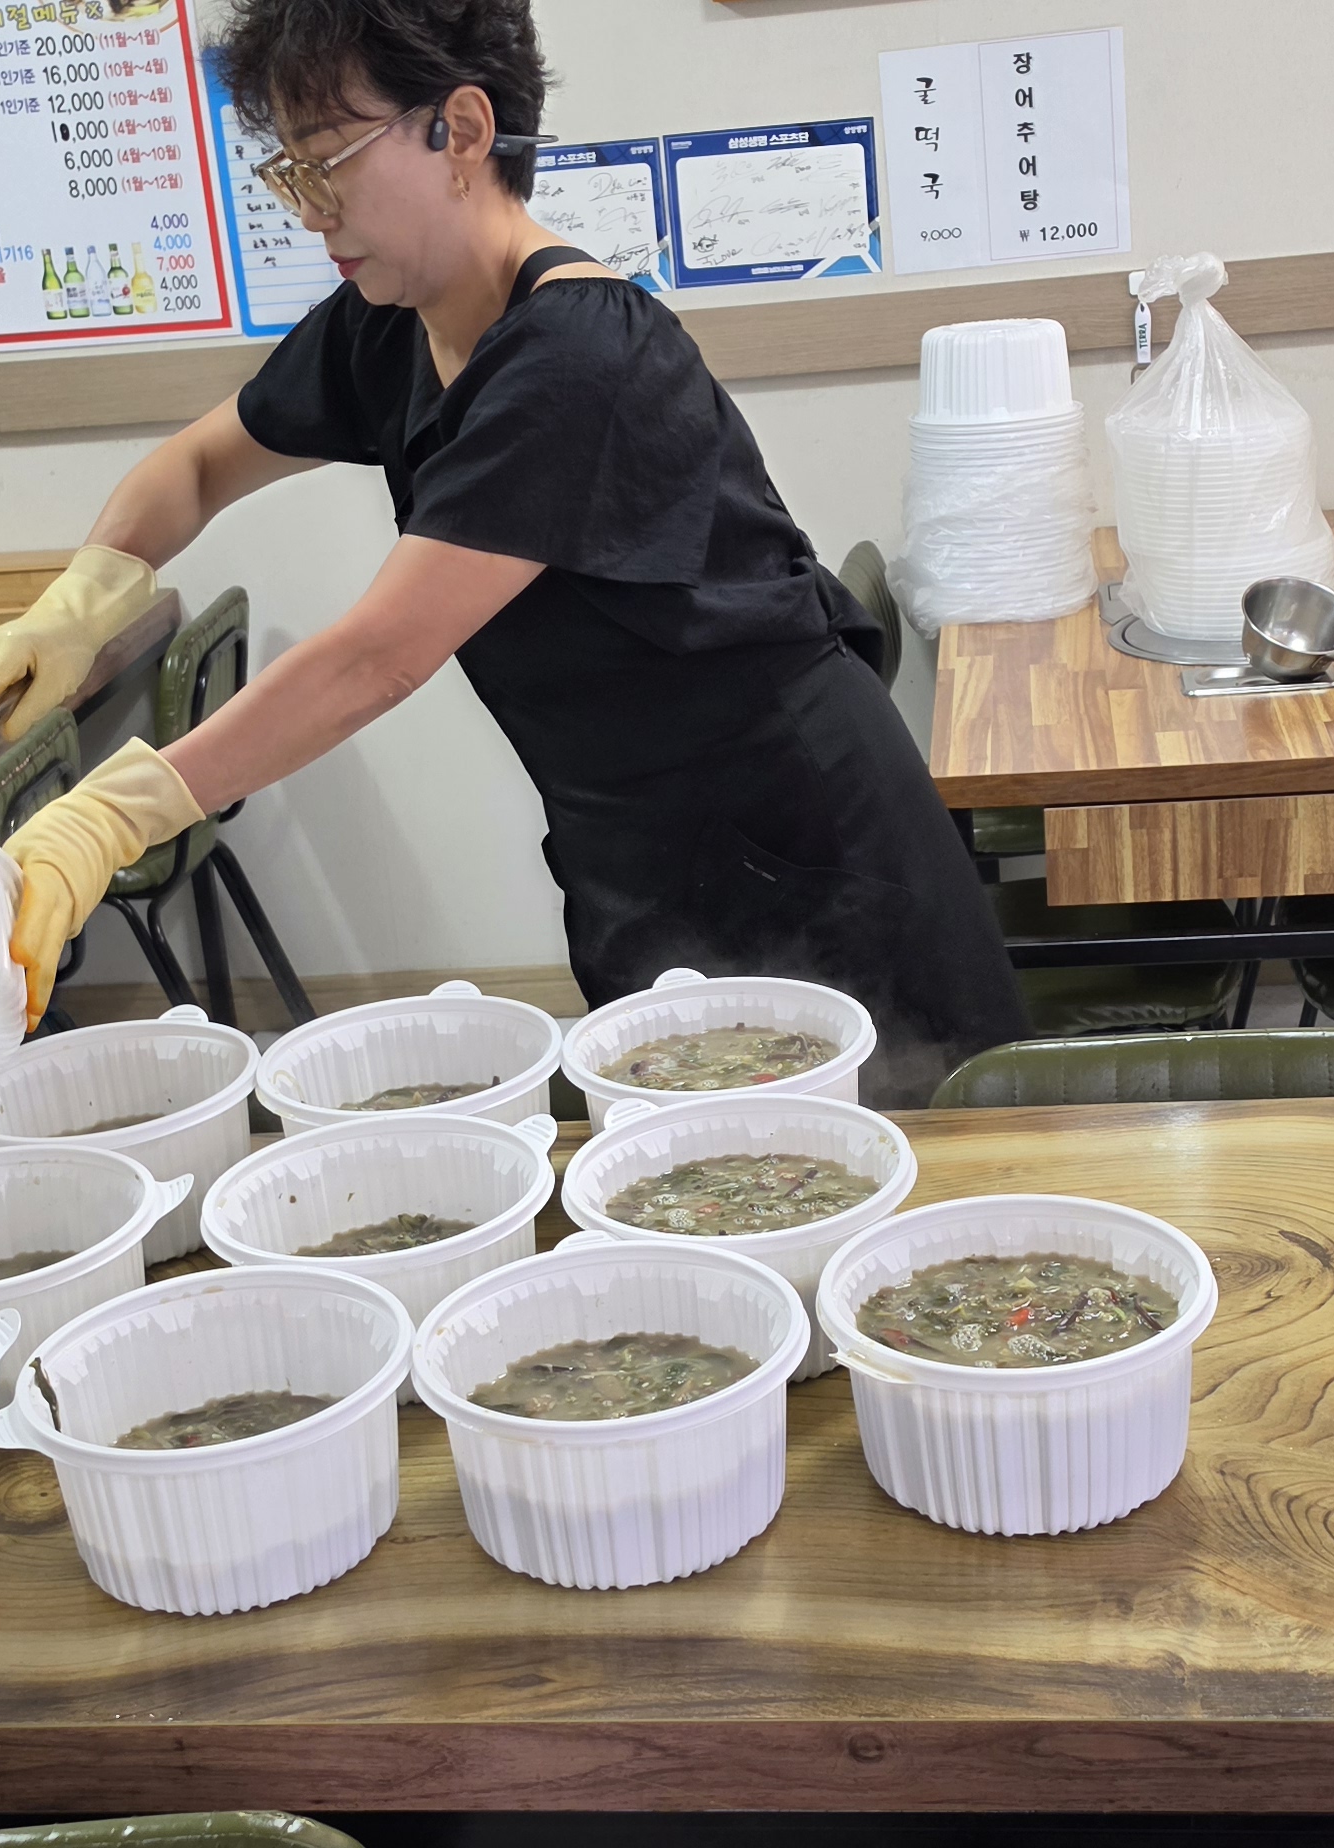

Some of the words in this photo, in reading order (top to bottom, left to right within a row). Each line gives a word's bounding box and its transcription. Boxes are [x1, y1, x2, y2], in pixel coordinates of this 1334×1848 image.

[35, 33, 95, 57] 20,000
[42, 62, 99, 86] 16,000
[0, 98, 41, 115] 1인기준
[47, 91, 104, 115] 12,000
[769, 131, 809, 145] 스포츠단
[64, 149, 113, 171] 6,000
[69, 177, 118, 200] 8,000
[151, 213, 189, 231] 4,000
[920, 227, 962, 242] 9,000
[1039, 222, 1098, 241] 12,000
[153, 234, 192, 251] 4,000
[156, 255, 195, 272] 7,000
[160, 274, 198, 292] 4,000
[163, 295, 201, 312] 2,000
[1138, 323, 1148, 349] TERRA
